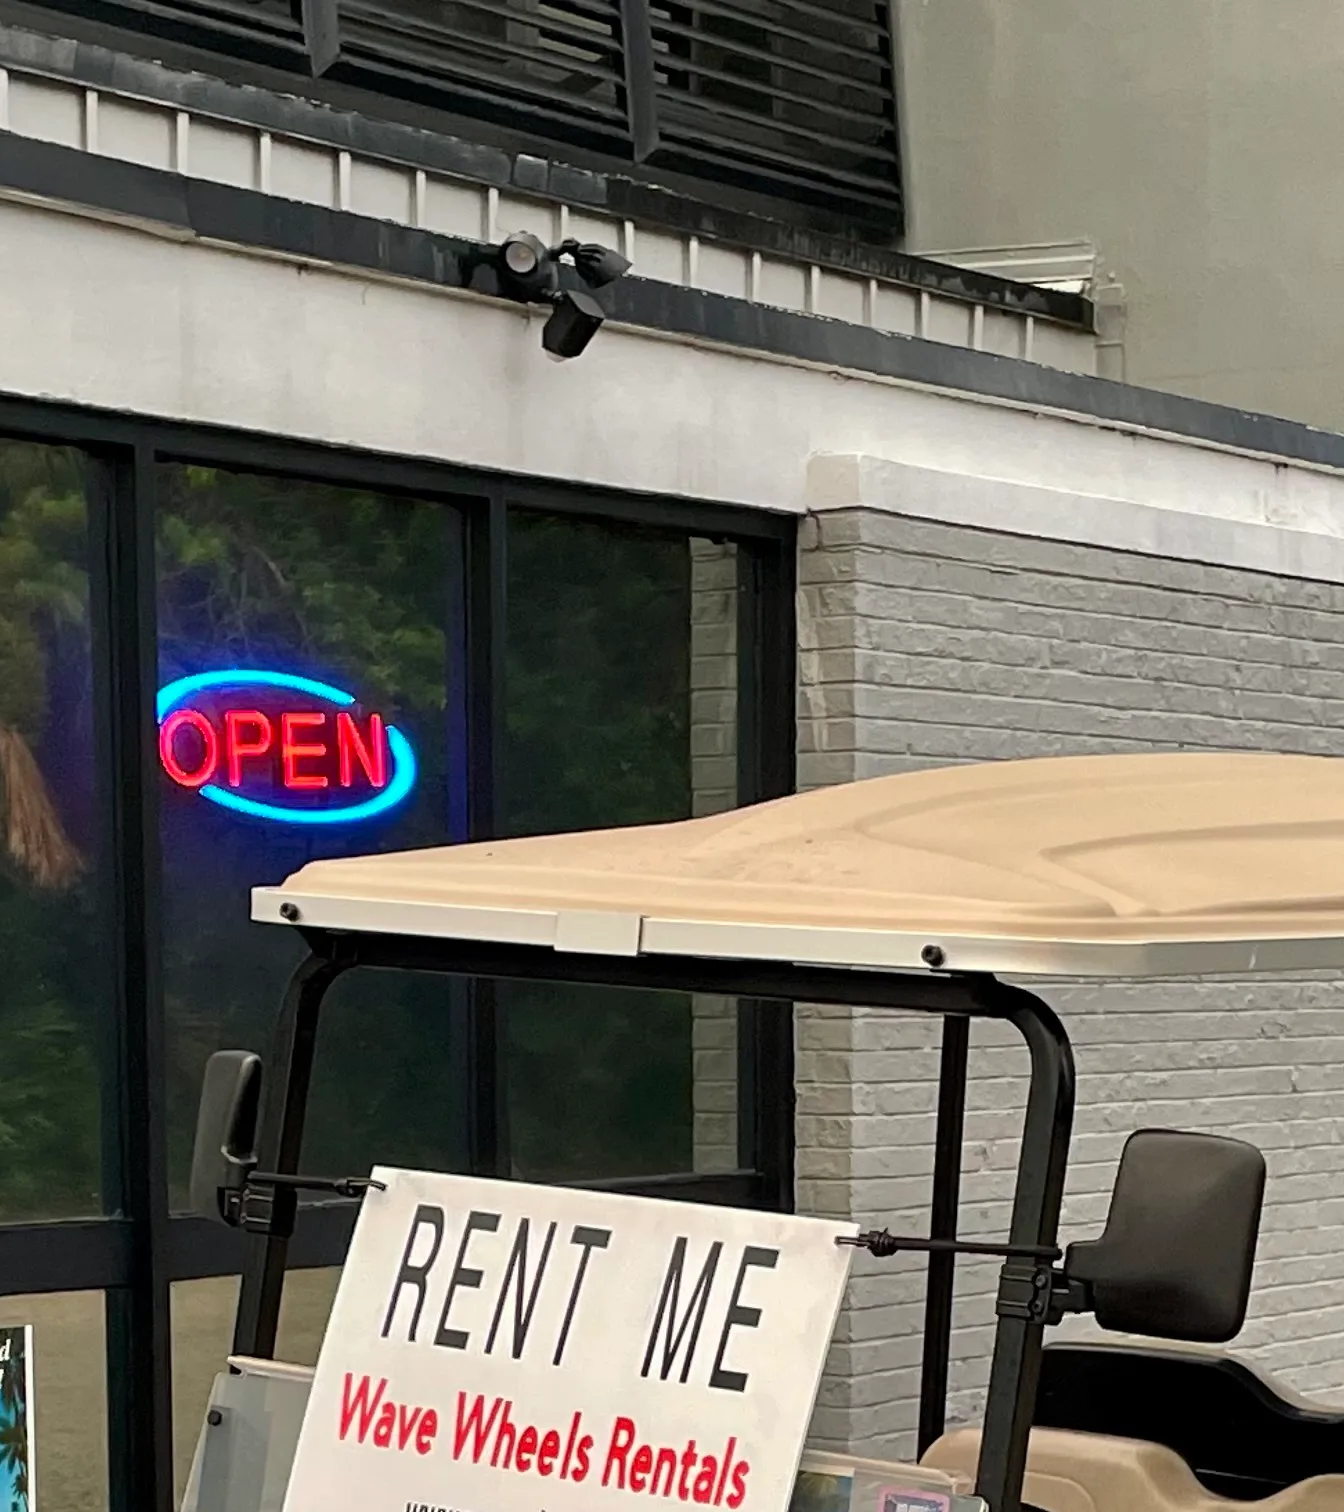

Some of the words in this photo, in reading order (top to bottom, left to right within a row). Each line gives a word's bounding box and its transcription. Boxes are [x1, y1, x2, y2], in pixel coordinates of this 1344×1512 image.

[159, 709, 386, 787] OPEN
[381, 1203, 613, 1366] RENT
[640, 1236, 781, 1392] ME
[338, 1372, 438, 1455] Wave
[452, 1391, 594, 1482] Wheels
[601, 1416, 751, 1510] Rentals
